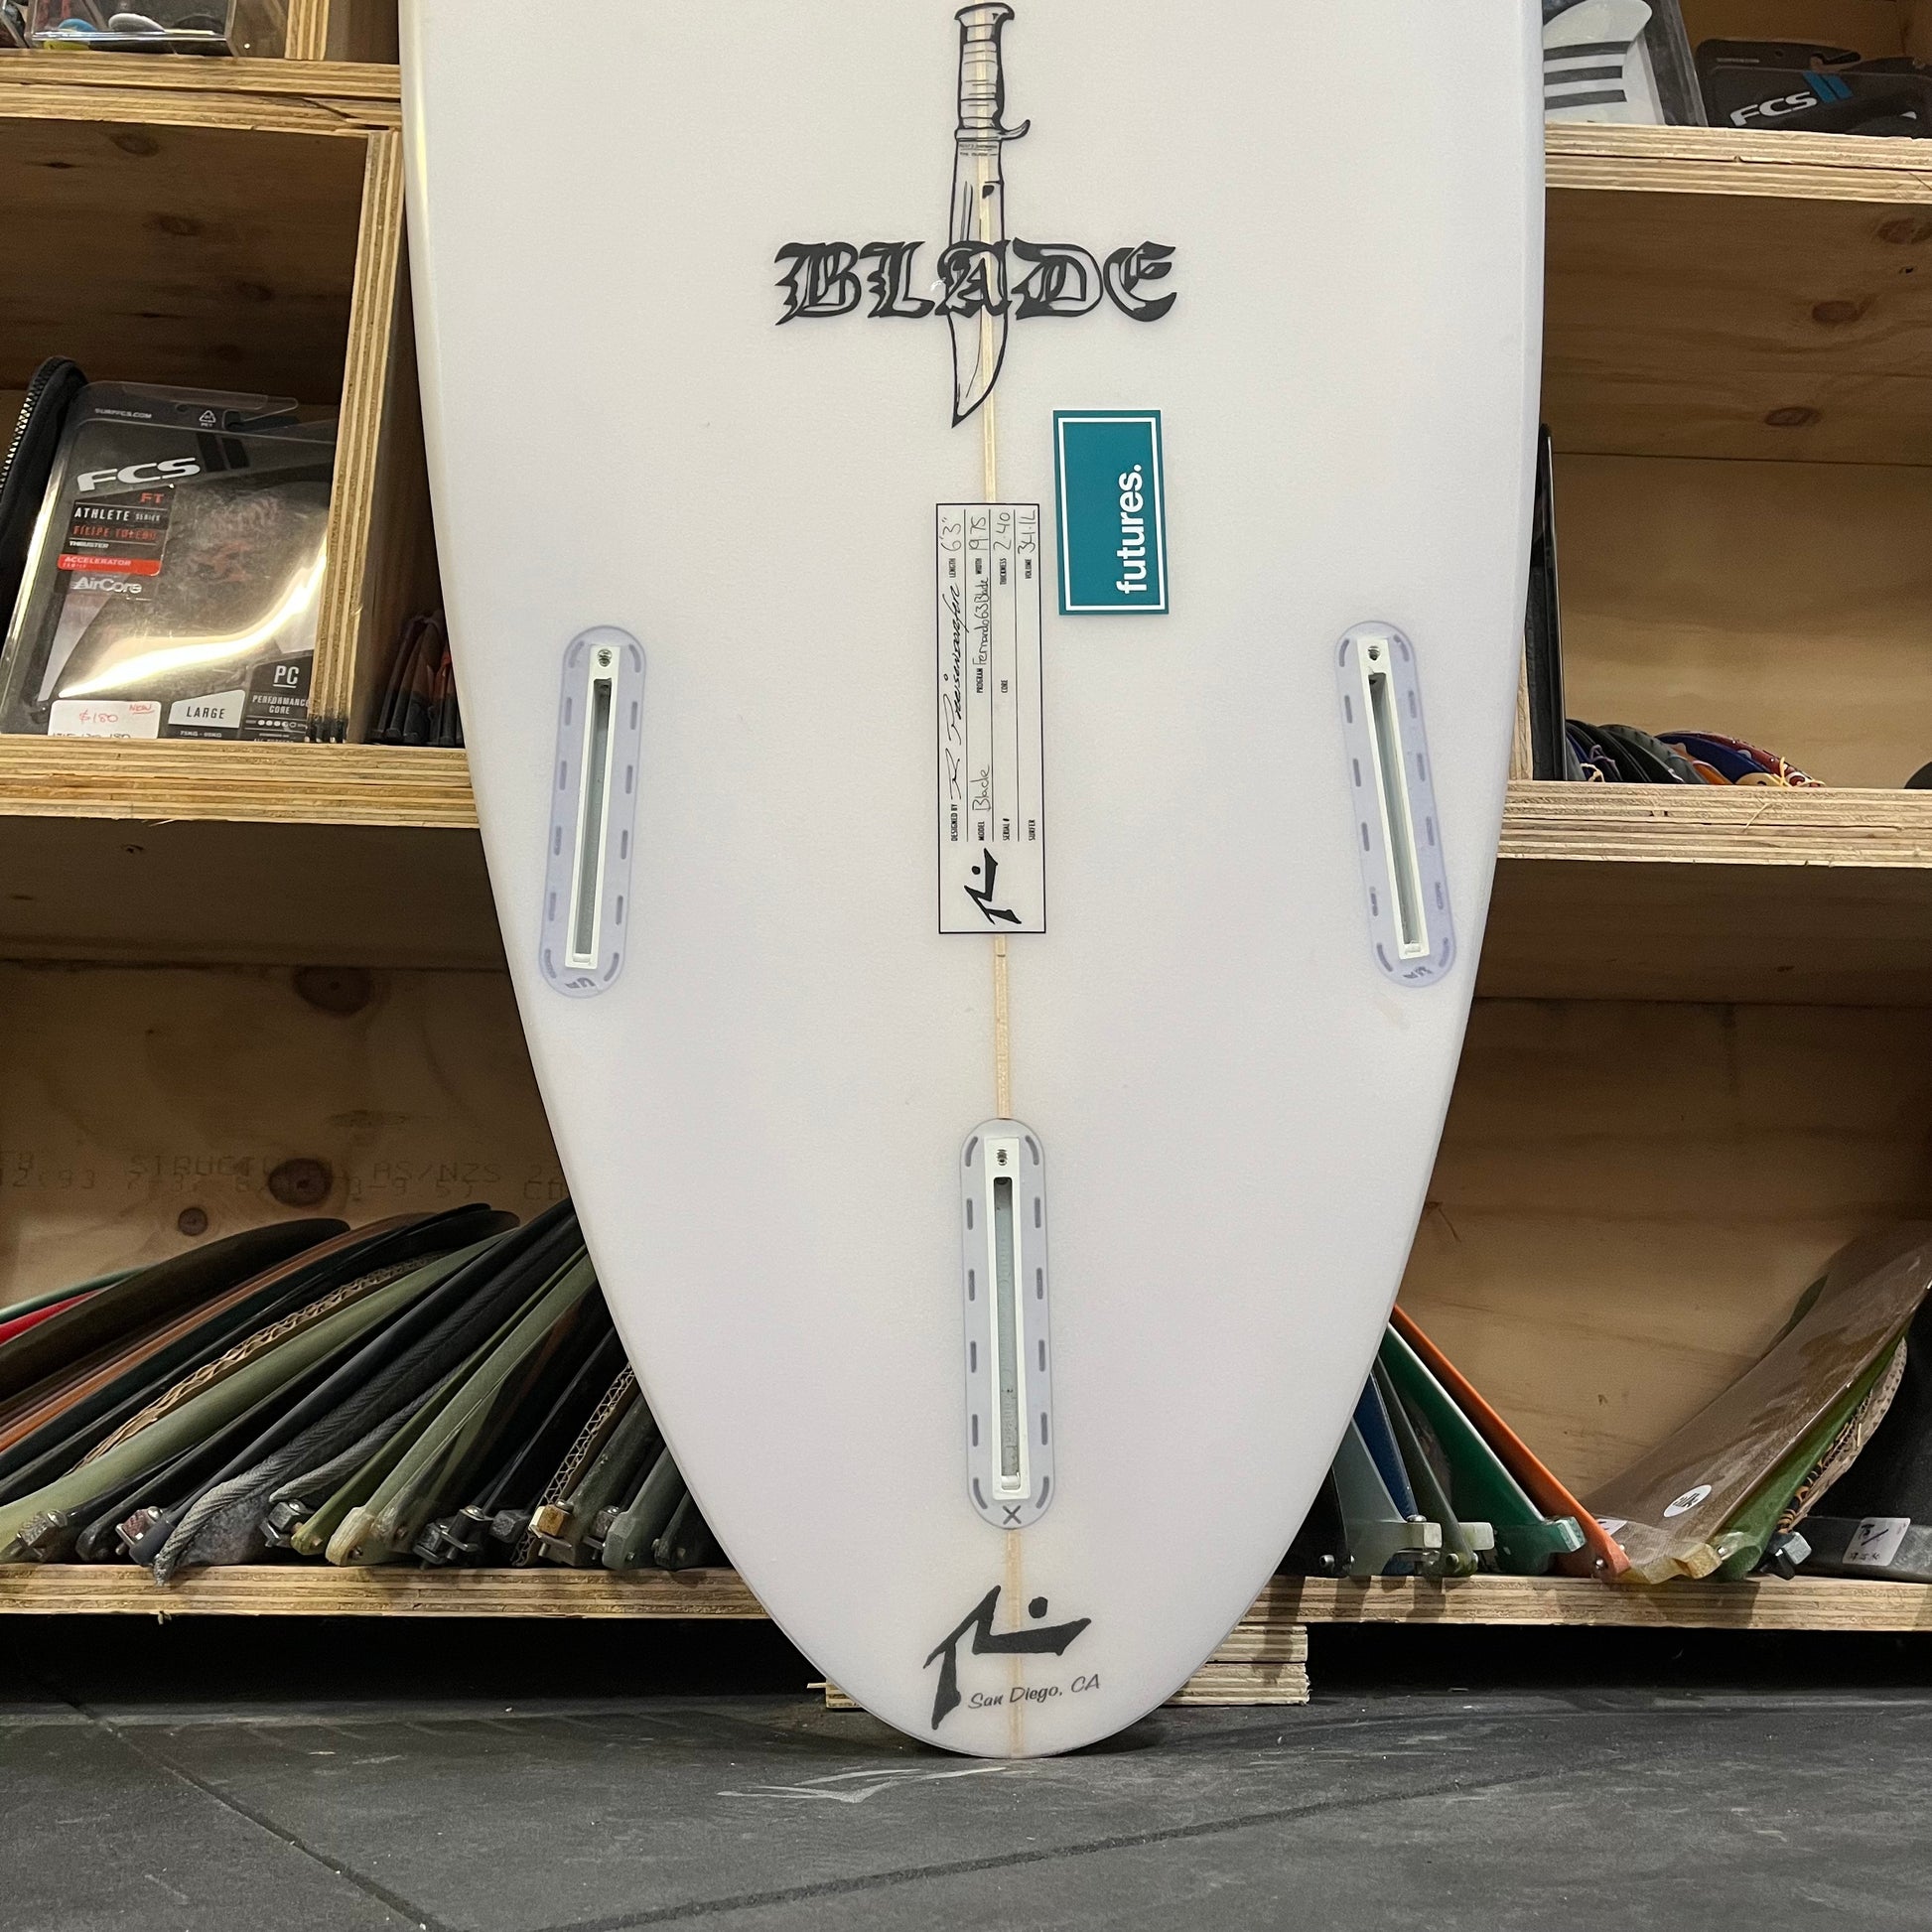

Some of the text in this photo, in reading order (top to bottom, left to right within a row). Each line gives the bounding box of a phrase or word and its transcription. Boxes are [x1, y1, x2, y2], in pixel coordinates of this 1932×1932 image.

[1729, 91, 1818, 127] FCS
[774, 238, 1177, 326] BLADE
[76, 457, 201, 492] FCS
[139, 492, 165, 504] FT
[73, 506, 130, 522] ATHLETE
[72, 525, 109, 537] FILIPE
[1116, 464, 1148, 595] futures.
[69, 540, 110, 549] THRUSTER
[64, 555, 132, 567] ACCELERATOR
[948, 557, 957, 579] LENGTH
[999, 557, 1008, 586] THICKNESS
[1024, 558, 1033, 580] VOLUME
[70, 576, 143, 595] AirCore
[274, 664, 301, 686] PC
[1000, 679, 1009, 694] CORE
[186, 706, 225, 720] LARGE
[268, 705, 291, 715] CORE
[969, 763, 992, 812] Blade
[950, 812, 959, 842] DESIGNED
[977, 820, 986, 842] MODEL
[1002, 823, 1011, 842] SERIAL
[1028, 819, 1036, 842] SURFER
[967, 1673, 1100, 1710] San Diego, CA
